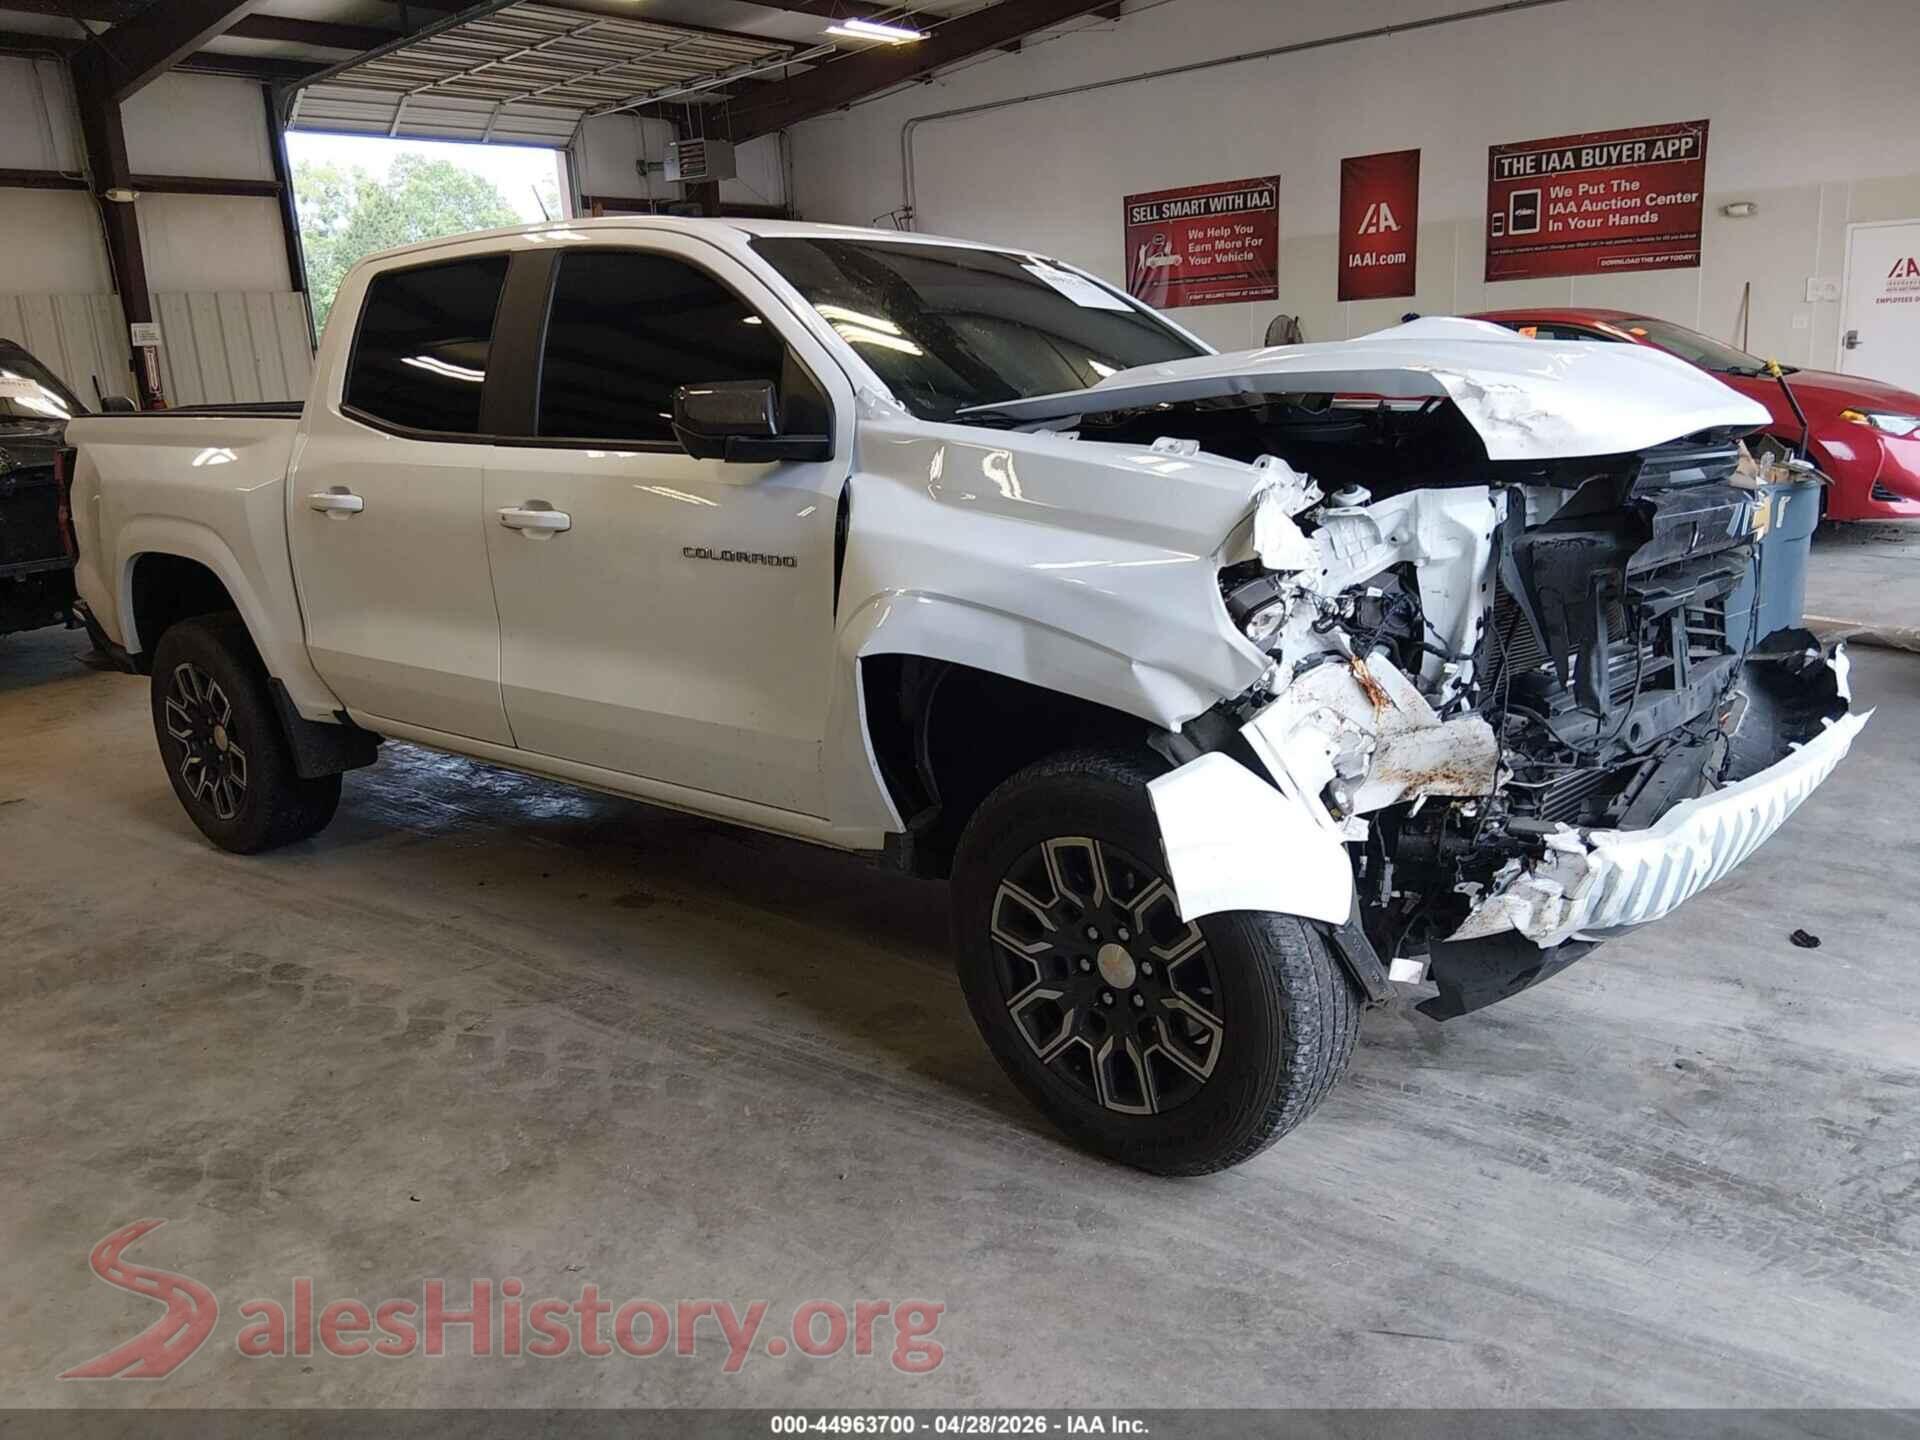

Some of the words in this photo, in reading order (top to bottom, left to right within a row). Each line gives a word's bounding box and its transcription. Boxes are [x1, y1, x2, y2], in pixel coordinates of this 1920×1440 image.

[1501, 156, 1536, 177] THE
[1541, 151, 1575, 172] IAA
[1581, 143, 1645, 168] BUYER
[1651, 136, 1693, 160] APP
[1550, 185, 1573, 199] We
[1578, 182, 1605, 196] Put
[1611, 179, 1640, 193] The
[1132, 203, 1159, 222] SELL
[1162, 196, 1206, 219] SMART
[1209, 191, 1243, 212] WITH
[1246, 190, 1271, 208] IAA
[1549, 201, 1577, 216] IAA
[1580, 195, 1641, 213] Auction
[1645, 191, 1698, 207] Center
[1548, 217, 1563, 232] In
[1568, 213, 1602, 230] Your
[1608, 210, 1659, 227] Hands
[1188, 228, 1204, 240] We
[1207, 226, 1231, 238] Help
[1234, 224, 1254, 234] You
[1188, 242, 1212, 253] Earn
[1215, 239, 1242, 250] More
[1245, 236, 1264, 247] For
[1188, 256, 1213, 266] Your
[1215, 250, 1254, 263] Vehicle
[1349, 251, 1406, 268] IAAI.com
[682, 547, 798, 568] COLORADO
